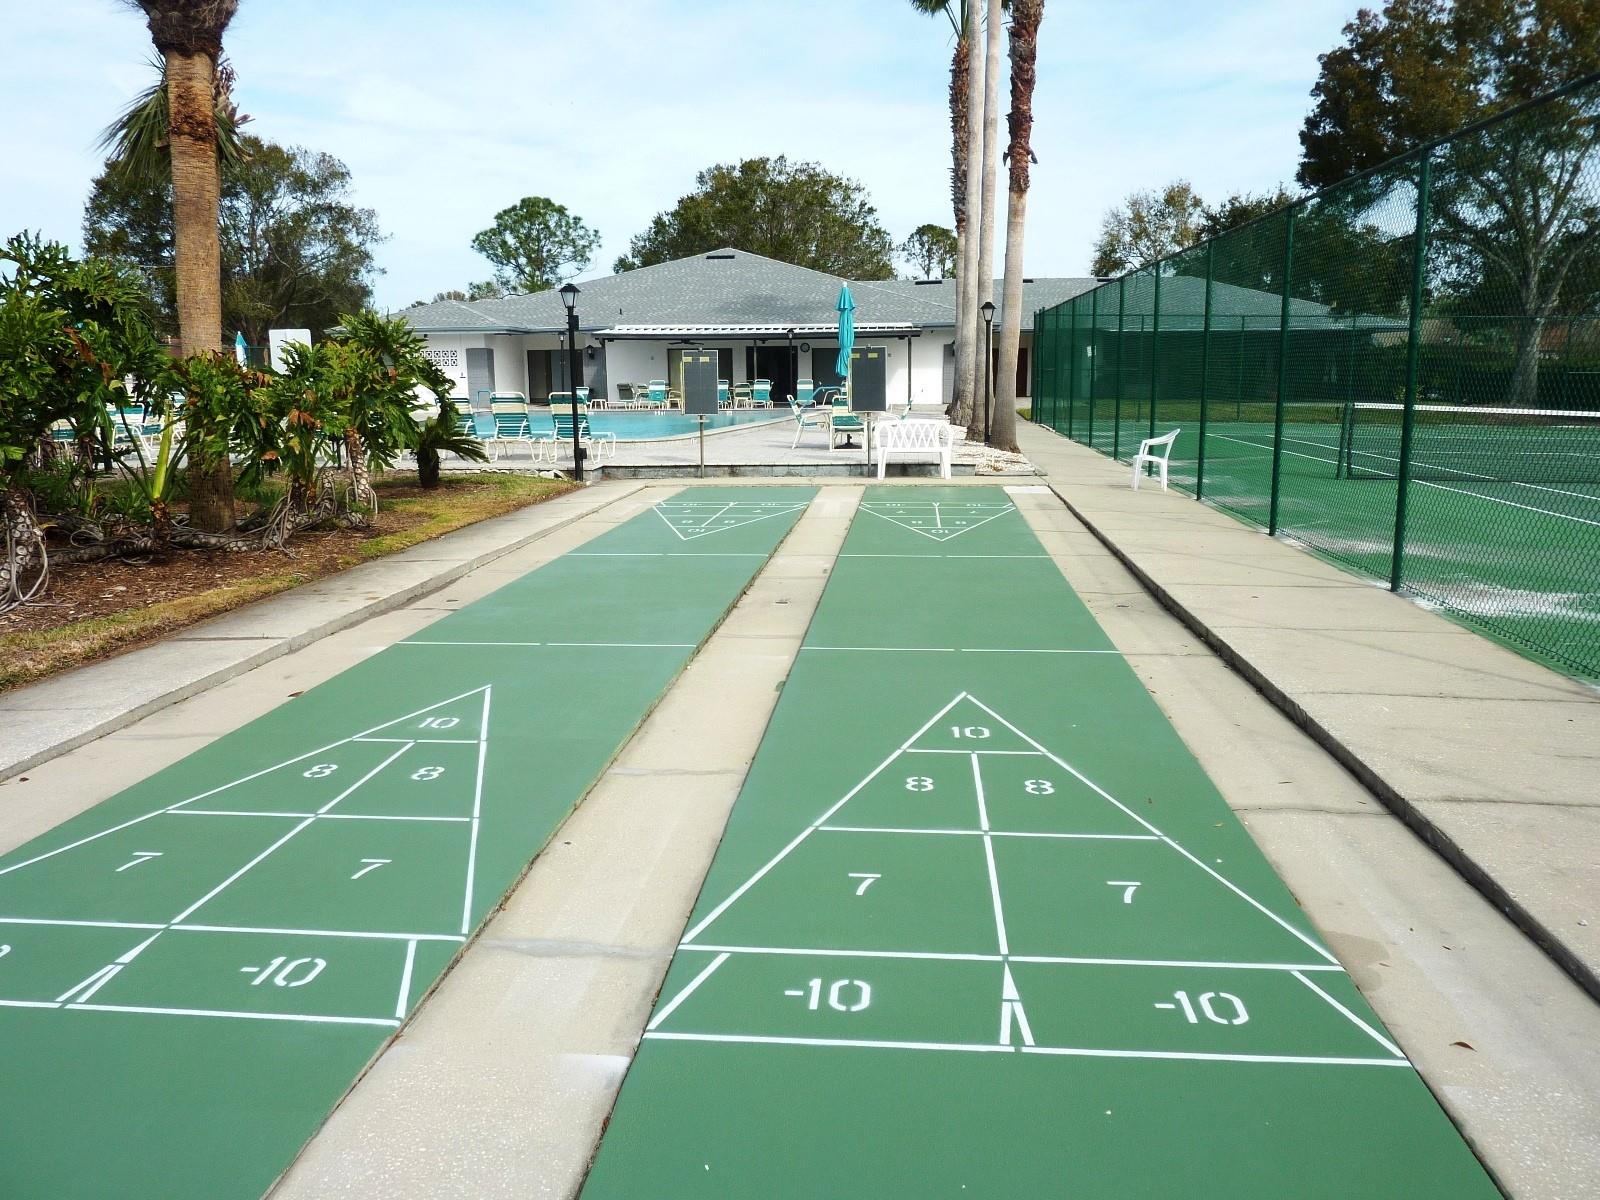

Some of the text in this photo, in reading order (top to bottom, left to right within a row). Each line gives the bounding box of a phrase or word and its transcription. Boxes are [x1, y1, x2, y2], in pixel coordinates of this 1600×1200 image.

[418, 717, 460, 729] 10
[950, 725, 991, 739] 10
[302, 764, 339, 778] 8
[410, 766, 446, 781] 8
[904, 776, 935, 792] 8
[1024, 779, 1056, 795] 8
[115, 851, 164, 872] 7
[350, 858, 393, 880] 7
[847, 872, 882, 896] 7
[1106, 880, 1142, 904] 7
[239, 956, 327, 988] -10
[783, 977, 872, 1012] -10
[1153, 990, 1250, 1026] -10
